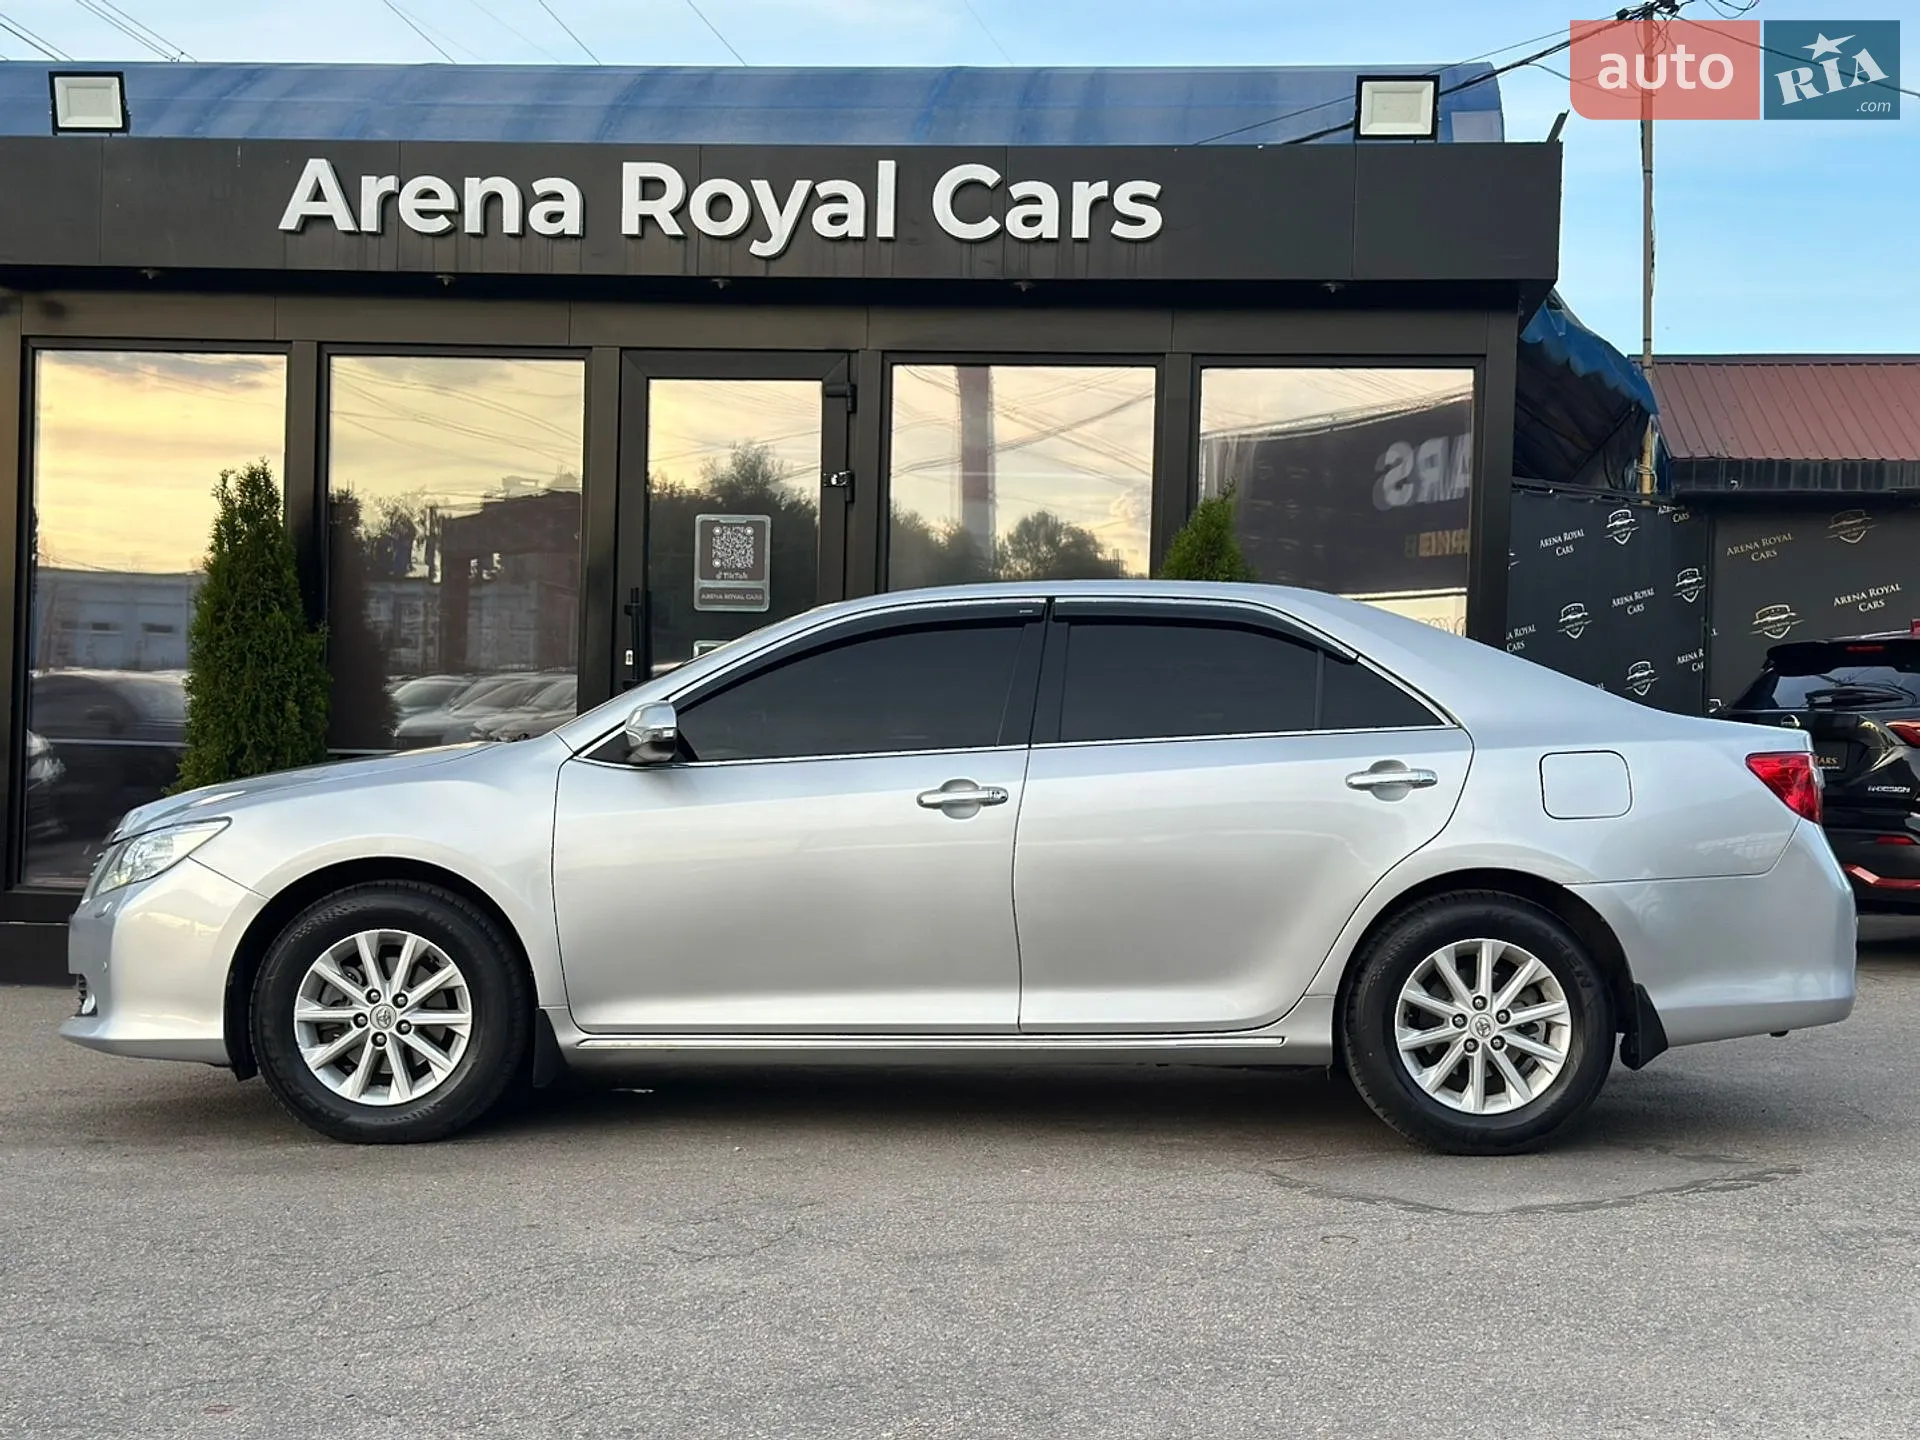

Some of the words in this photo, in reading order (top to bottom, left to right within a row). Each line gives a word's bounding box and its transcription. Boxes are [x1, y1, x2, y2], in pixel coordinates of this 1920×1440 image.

[279, 158, 584, 237] Arena
[621, 160, 897, 259] Royal
[932, 163, 1163, 241] Cars
[1539, 534, 1562, 549] ARENA
[1563, 528, 1585, 543] ROYAL
[1726, 541, 1760, 556] ARENA
[1761, 533, 1793, 548] ROYAL
[1555, 544, 1574, 557] CARS
[1751, 549, 1777, 562] CARS
[1611, 594, 1634, 608] ARENA
[1634, 587, 1655, 601] ROYAL
[1833, 591, 1867, 607] ARENA
[1869, 583, 1902, 598] ROYAL
[1626, 603, 1645, 615] CARS
[1858, 599, 1886, 612] CARS
[1514, 624, 1536, 639] ROYAL
[1507, 640, 1526, 652] CARS
[1676, 651, 1698, 665] ARENA
